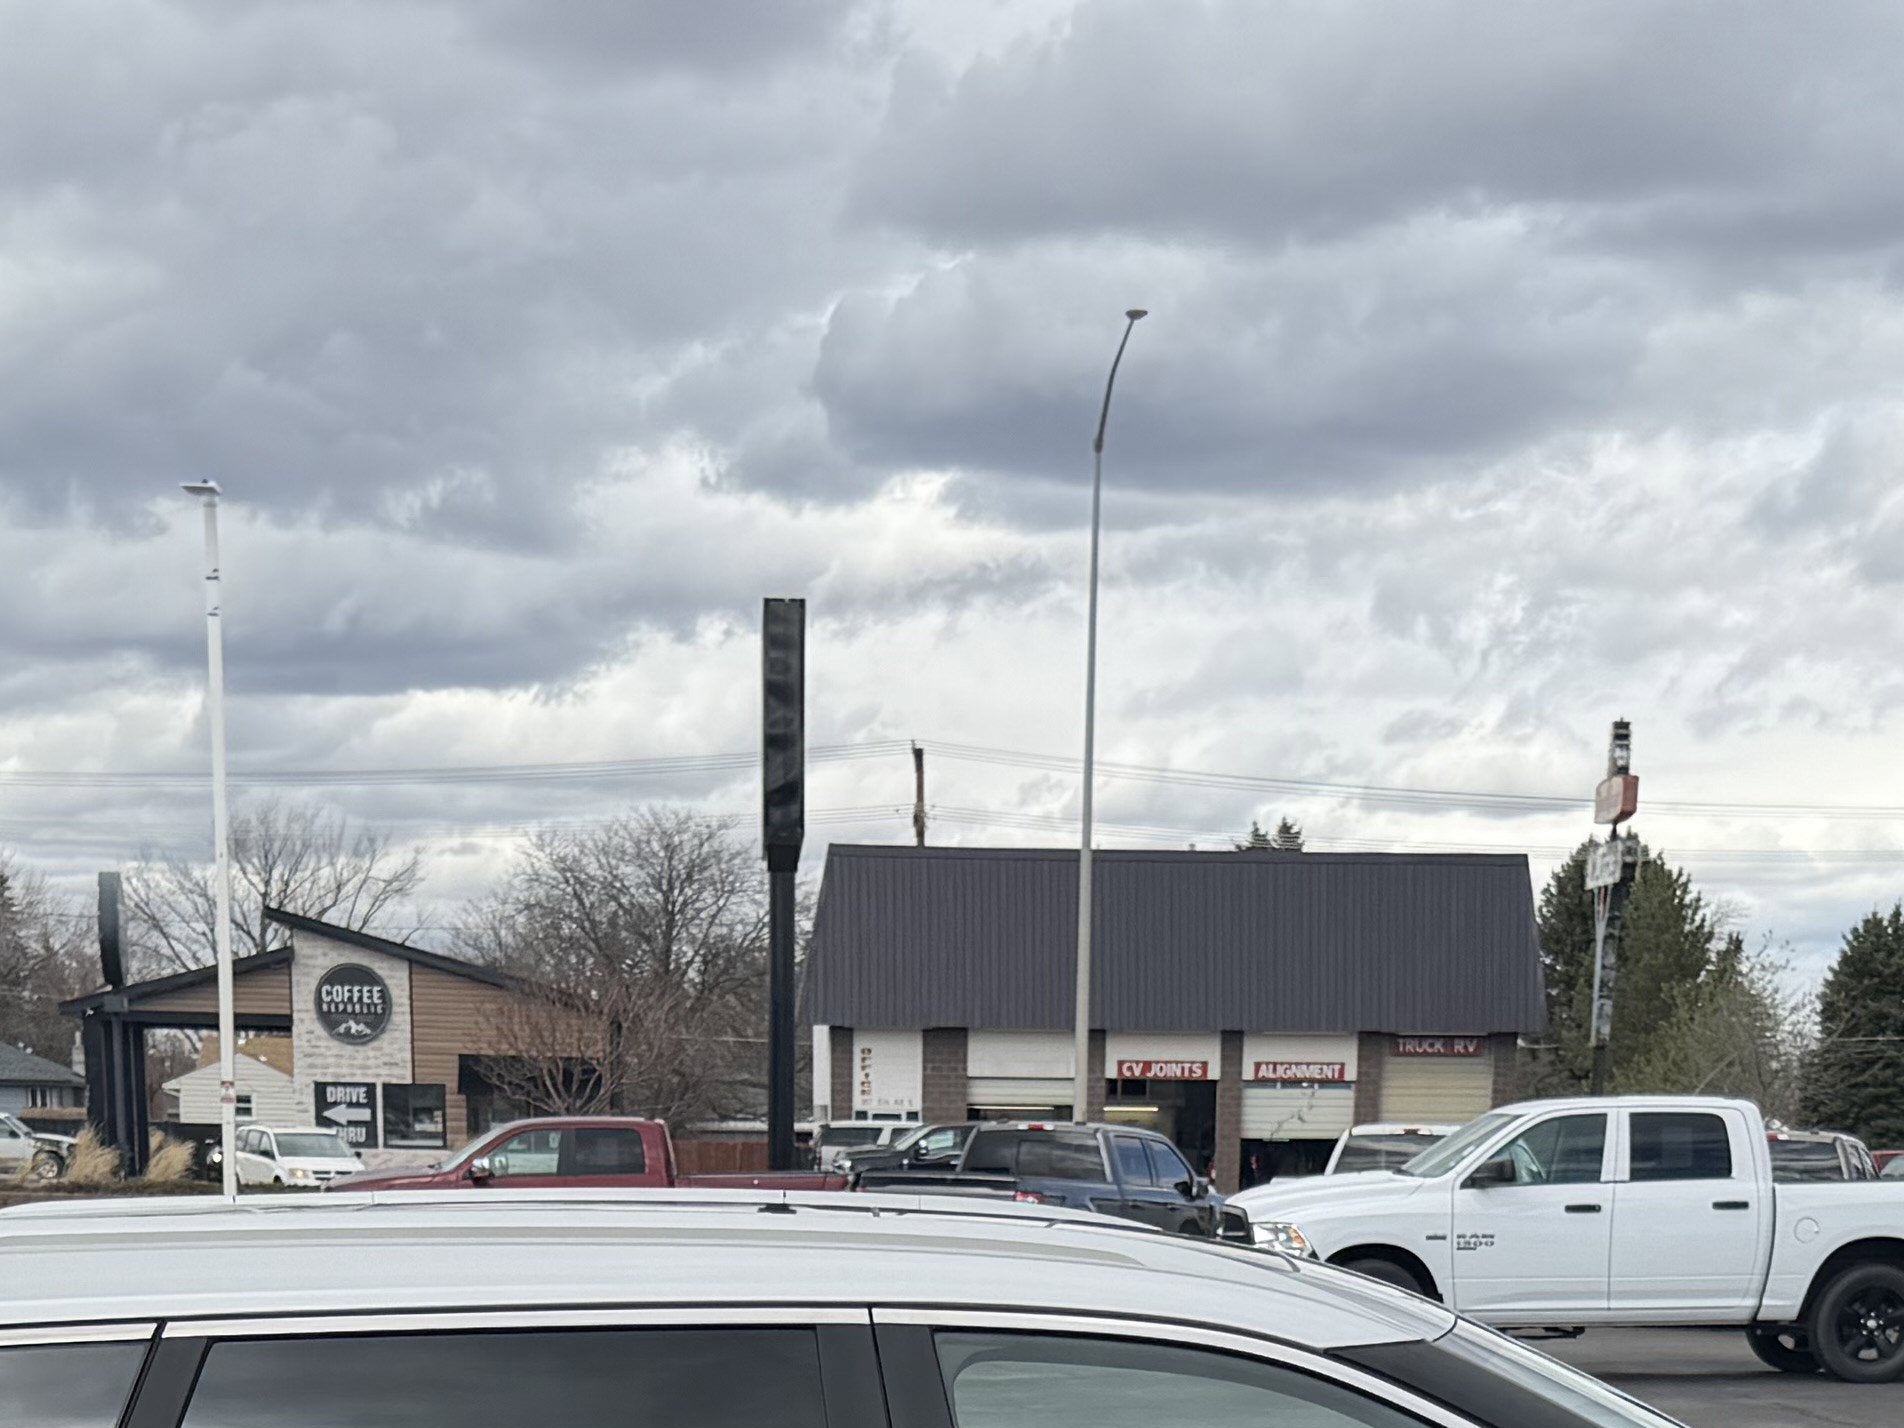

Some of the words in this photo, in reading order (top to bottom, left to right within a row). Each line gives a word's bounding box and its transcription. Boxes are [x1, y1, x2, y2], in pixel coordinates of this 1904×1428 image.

[321, 985, 384, 1004] COFFEE
[1397, 1038, 1445, 1053] TRUCK
[1454, 1038, 1477, 1053] RV
[1121, 1062, 1144, 1078] CV
[1145, 1062, 1203, 1078] JOINTS
[1257, 1063, 1342, 1079] ALIGNMENT
[326, 1086, 368, 1104] DRIVE
[336, 1127, 366, 1143] HRU
